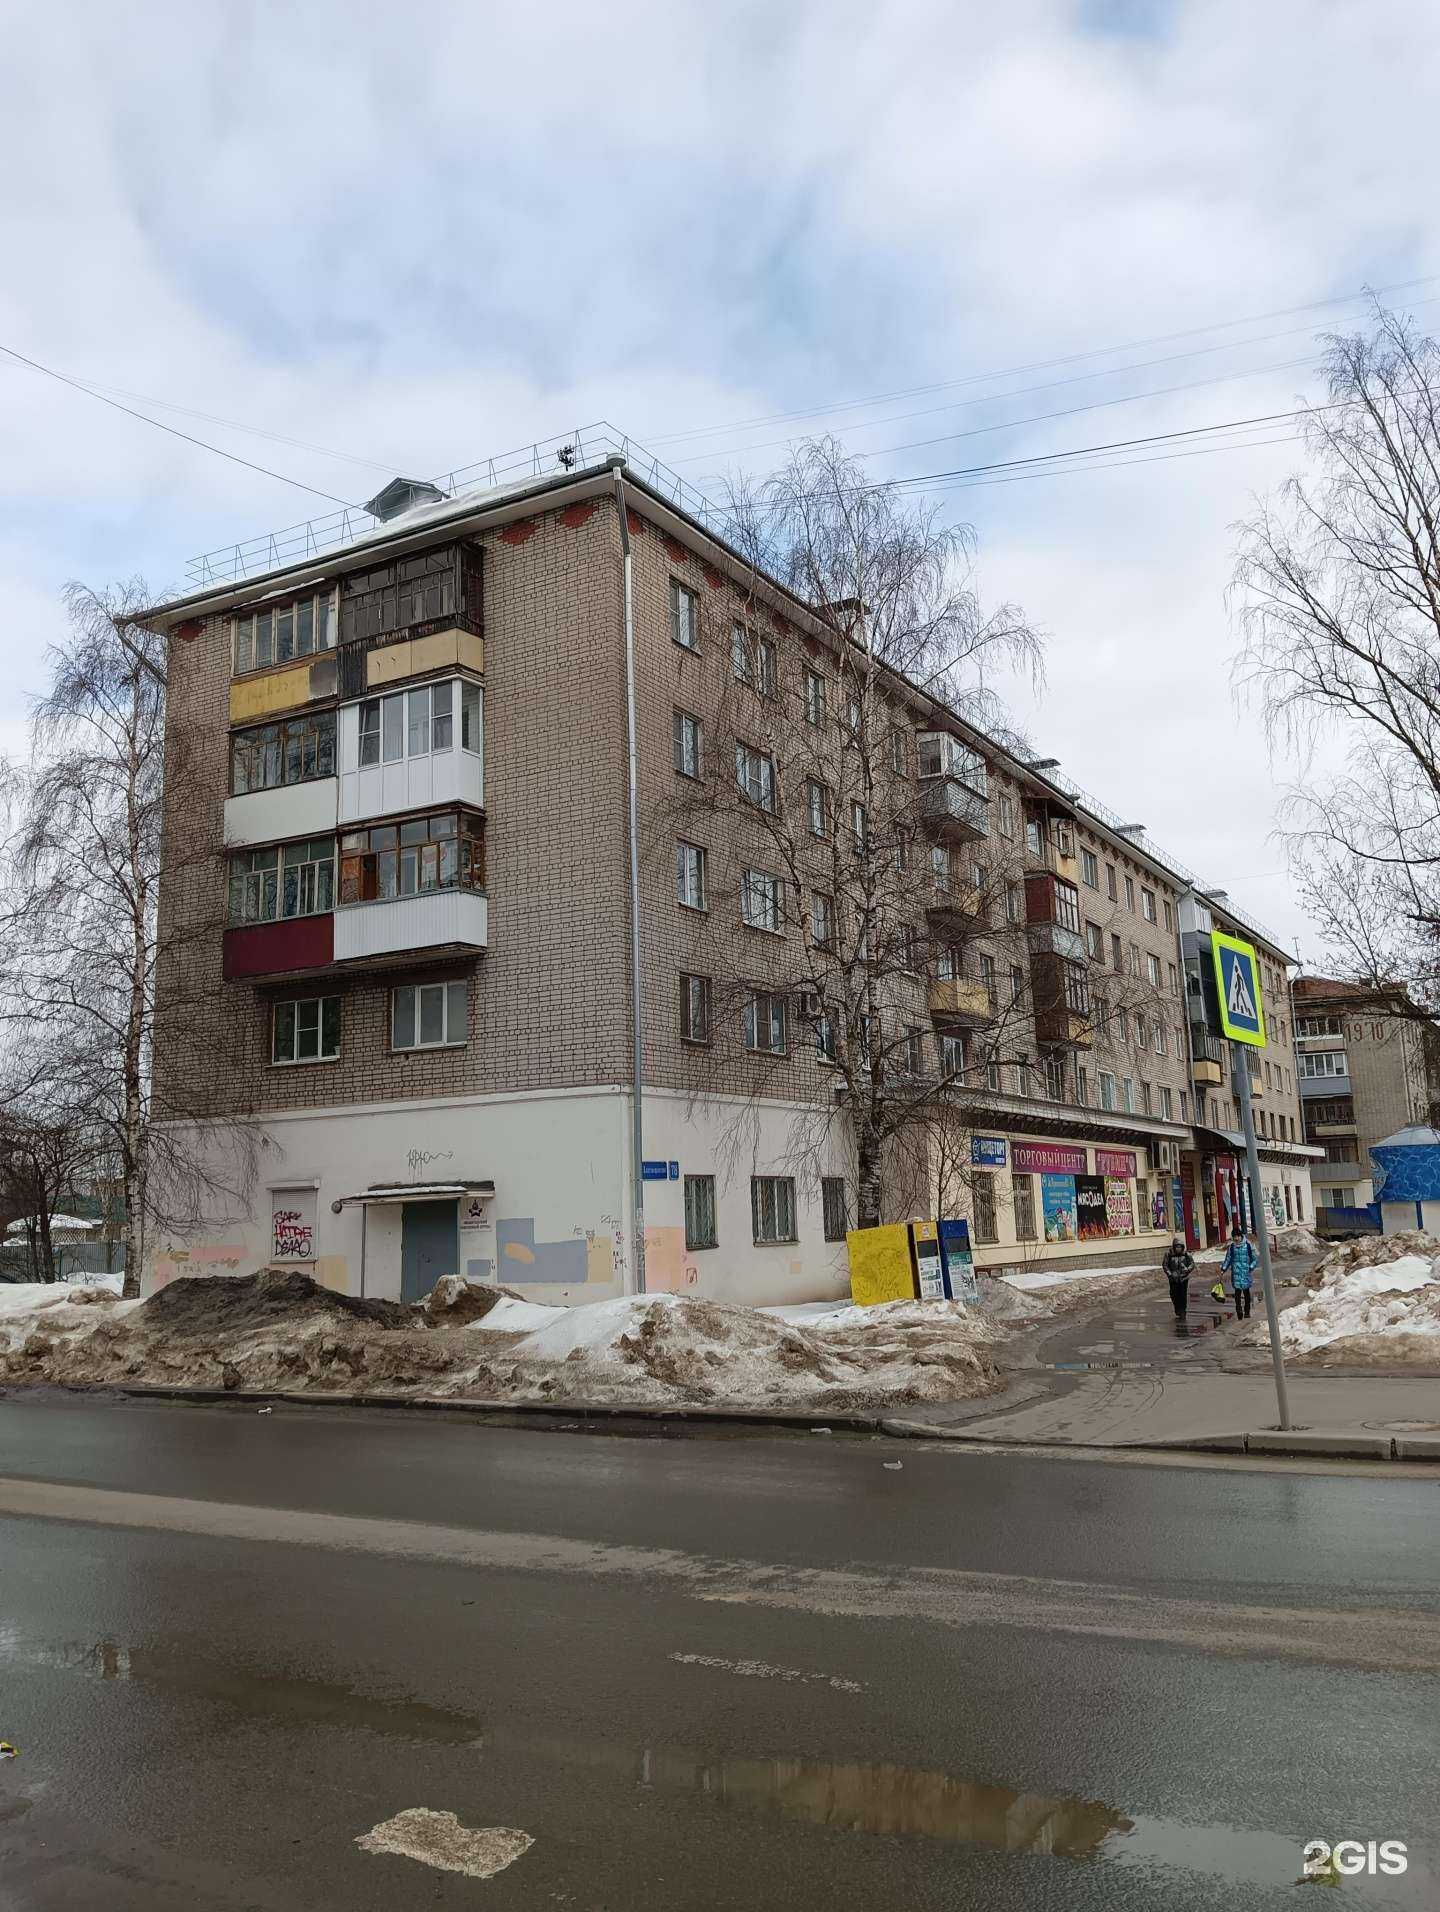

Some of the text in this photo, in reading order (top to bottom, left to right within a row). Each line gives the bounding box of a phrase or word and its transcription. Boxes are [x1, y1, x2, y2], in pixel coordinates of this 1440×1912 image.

[1344, 1022, 1384, 1042] 1970
[1014, 1149, 1085, 1169] ТОРГОВЫЙ ЦЕНТР
